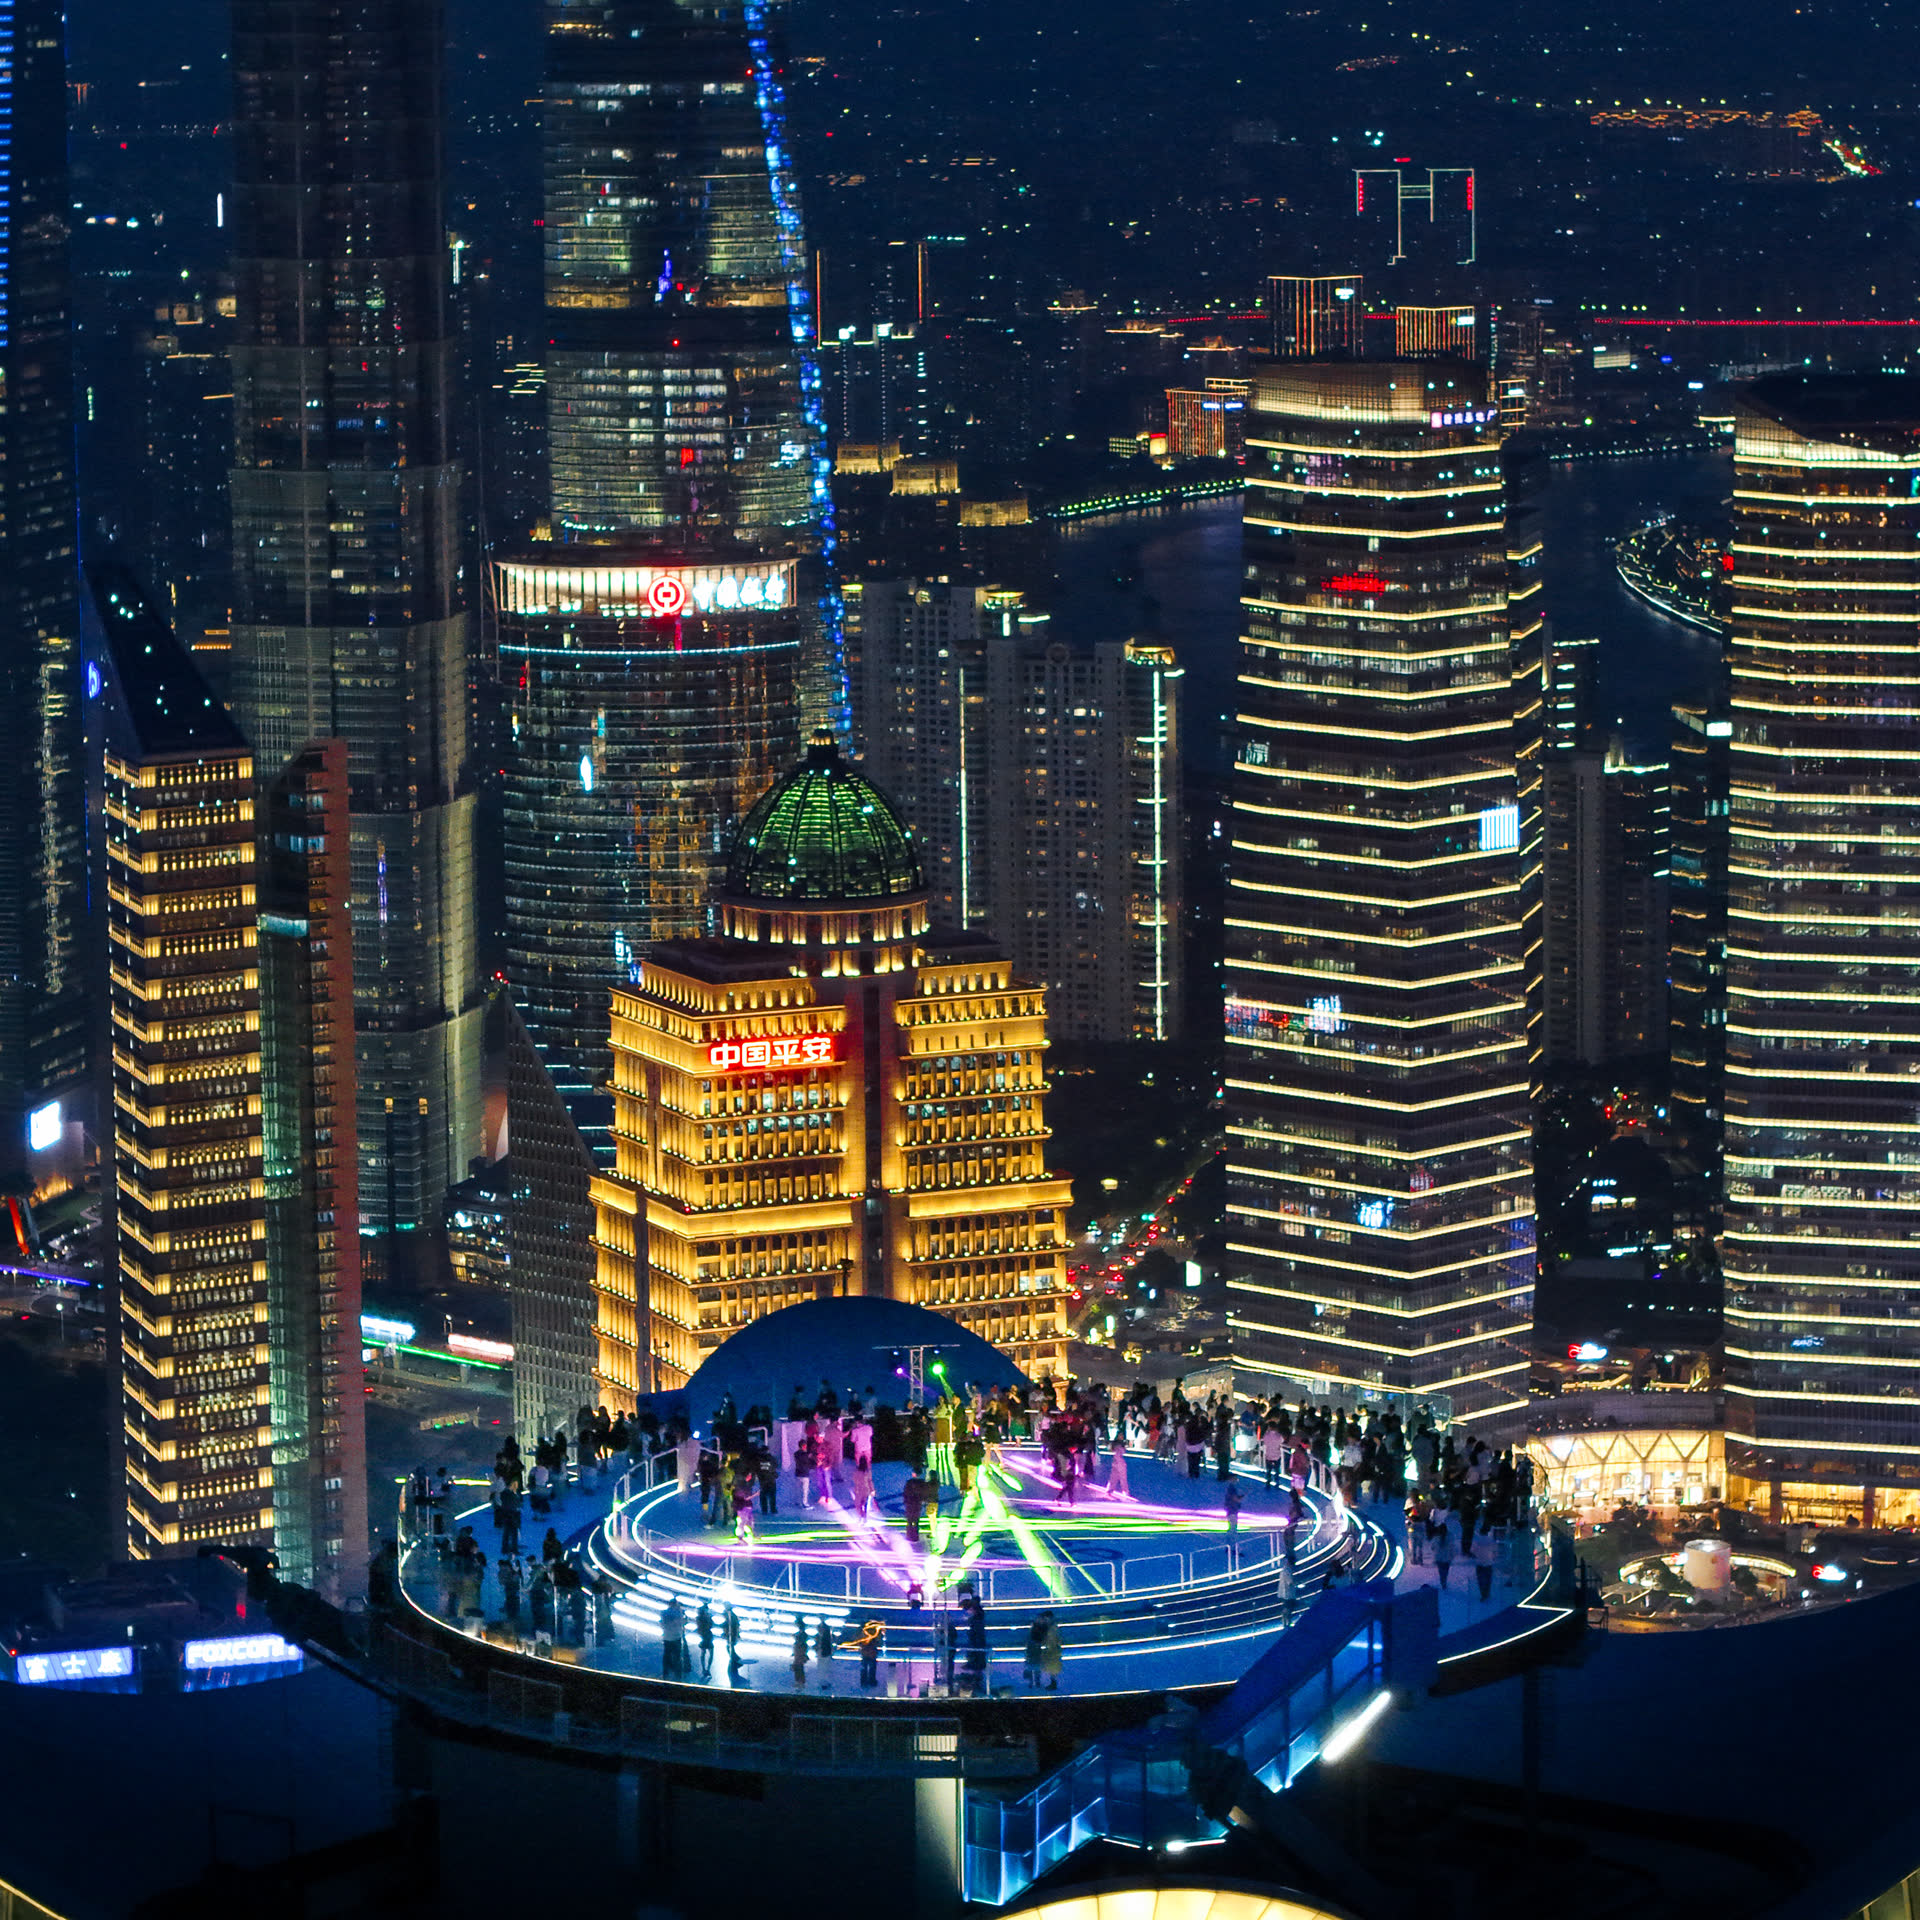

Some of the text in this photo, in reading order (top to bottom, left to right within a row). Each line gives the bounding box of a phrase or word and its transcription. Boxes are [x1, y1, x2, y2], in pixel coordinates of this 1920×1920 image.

[710, 1036, 831, 1069] 中国平安
[26, 1650, 122, 1681] 富士康
